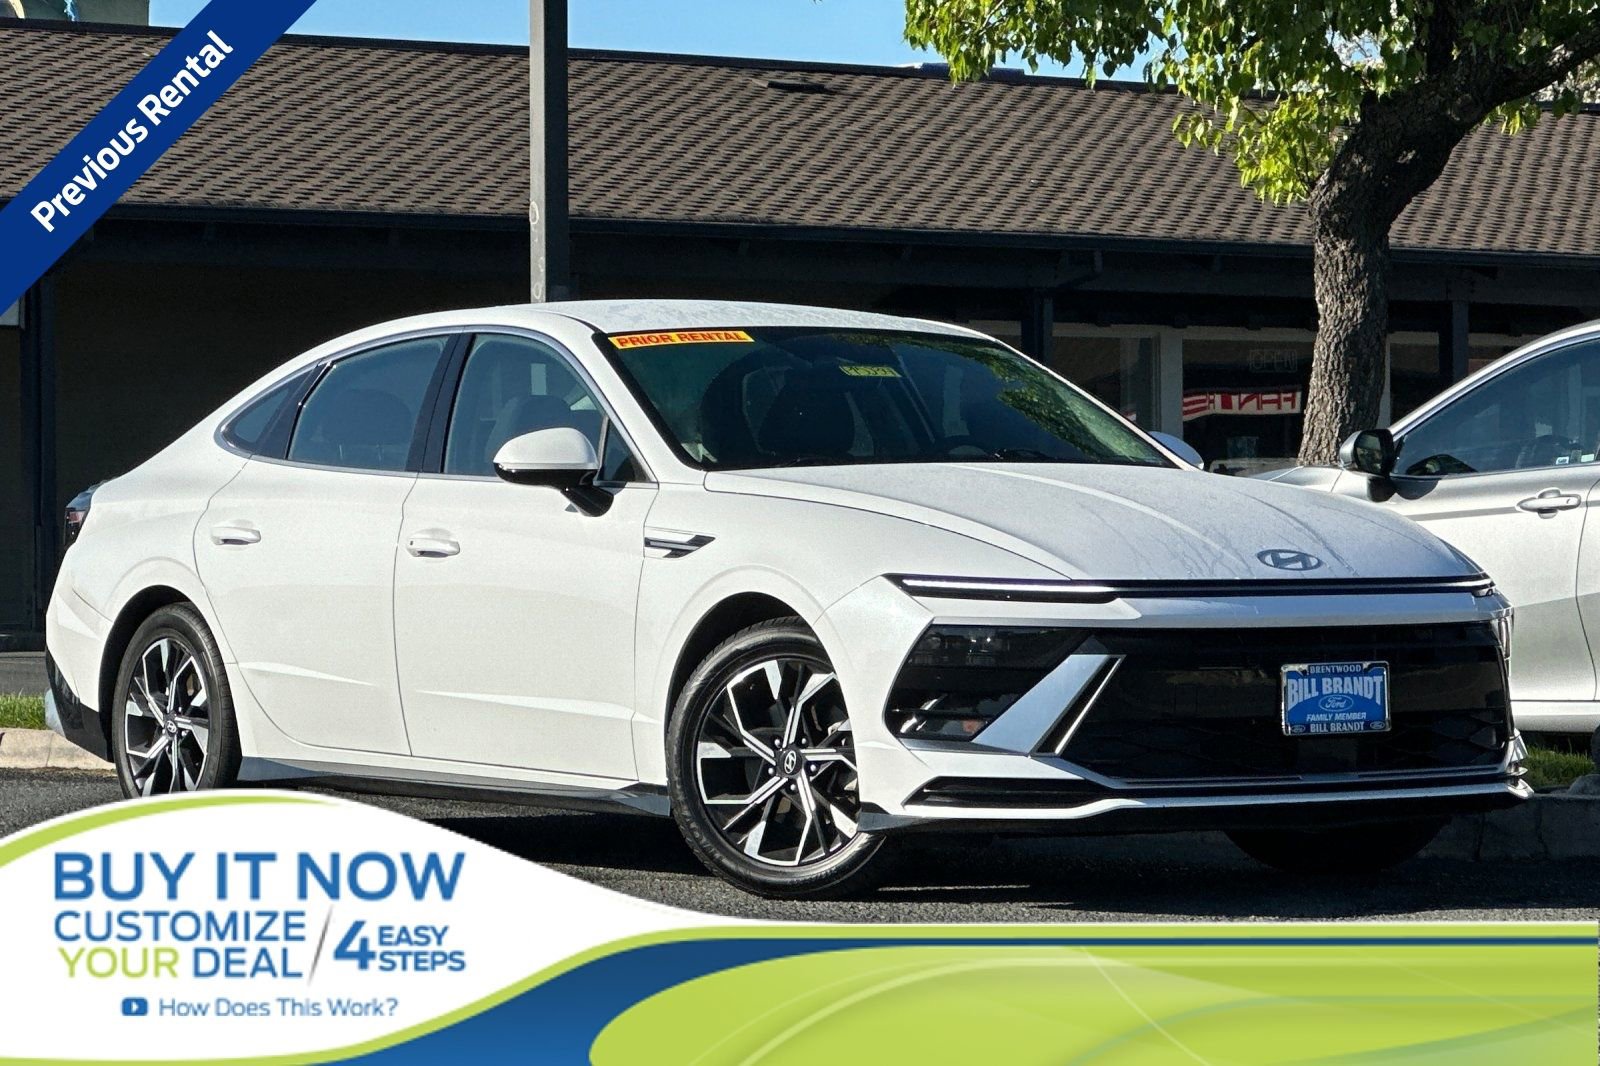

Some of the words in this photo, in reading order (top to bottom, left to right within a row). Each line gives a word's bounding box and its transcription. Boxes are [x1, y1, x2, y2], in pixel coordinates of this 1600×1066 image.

[616, 333, 674, 348] PRIOR
[676, 331, 746, 342] RENTAL
[1253, 351, 1294, 370] OPEN
[1310, 664, 1361, 674] BRENTWOOD
[1287, 678, 1319, 712] BILL
[1321, 675, 1384, 706] BRANDT
[1324, 696, 1347, 709] Ford
[1306, 713, 1334, 722] FAMILY
[1334, 712, 1367, 721] MEMBER
[1310, 723, 1329, 733] BILL
[1330, 721, 1365, 732] BRANDT
